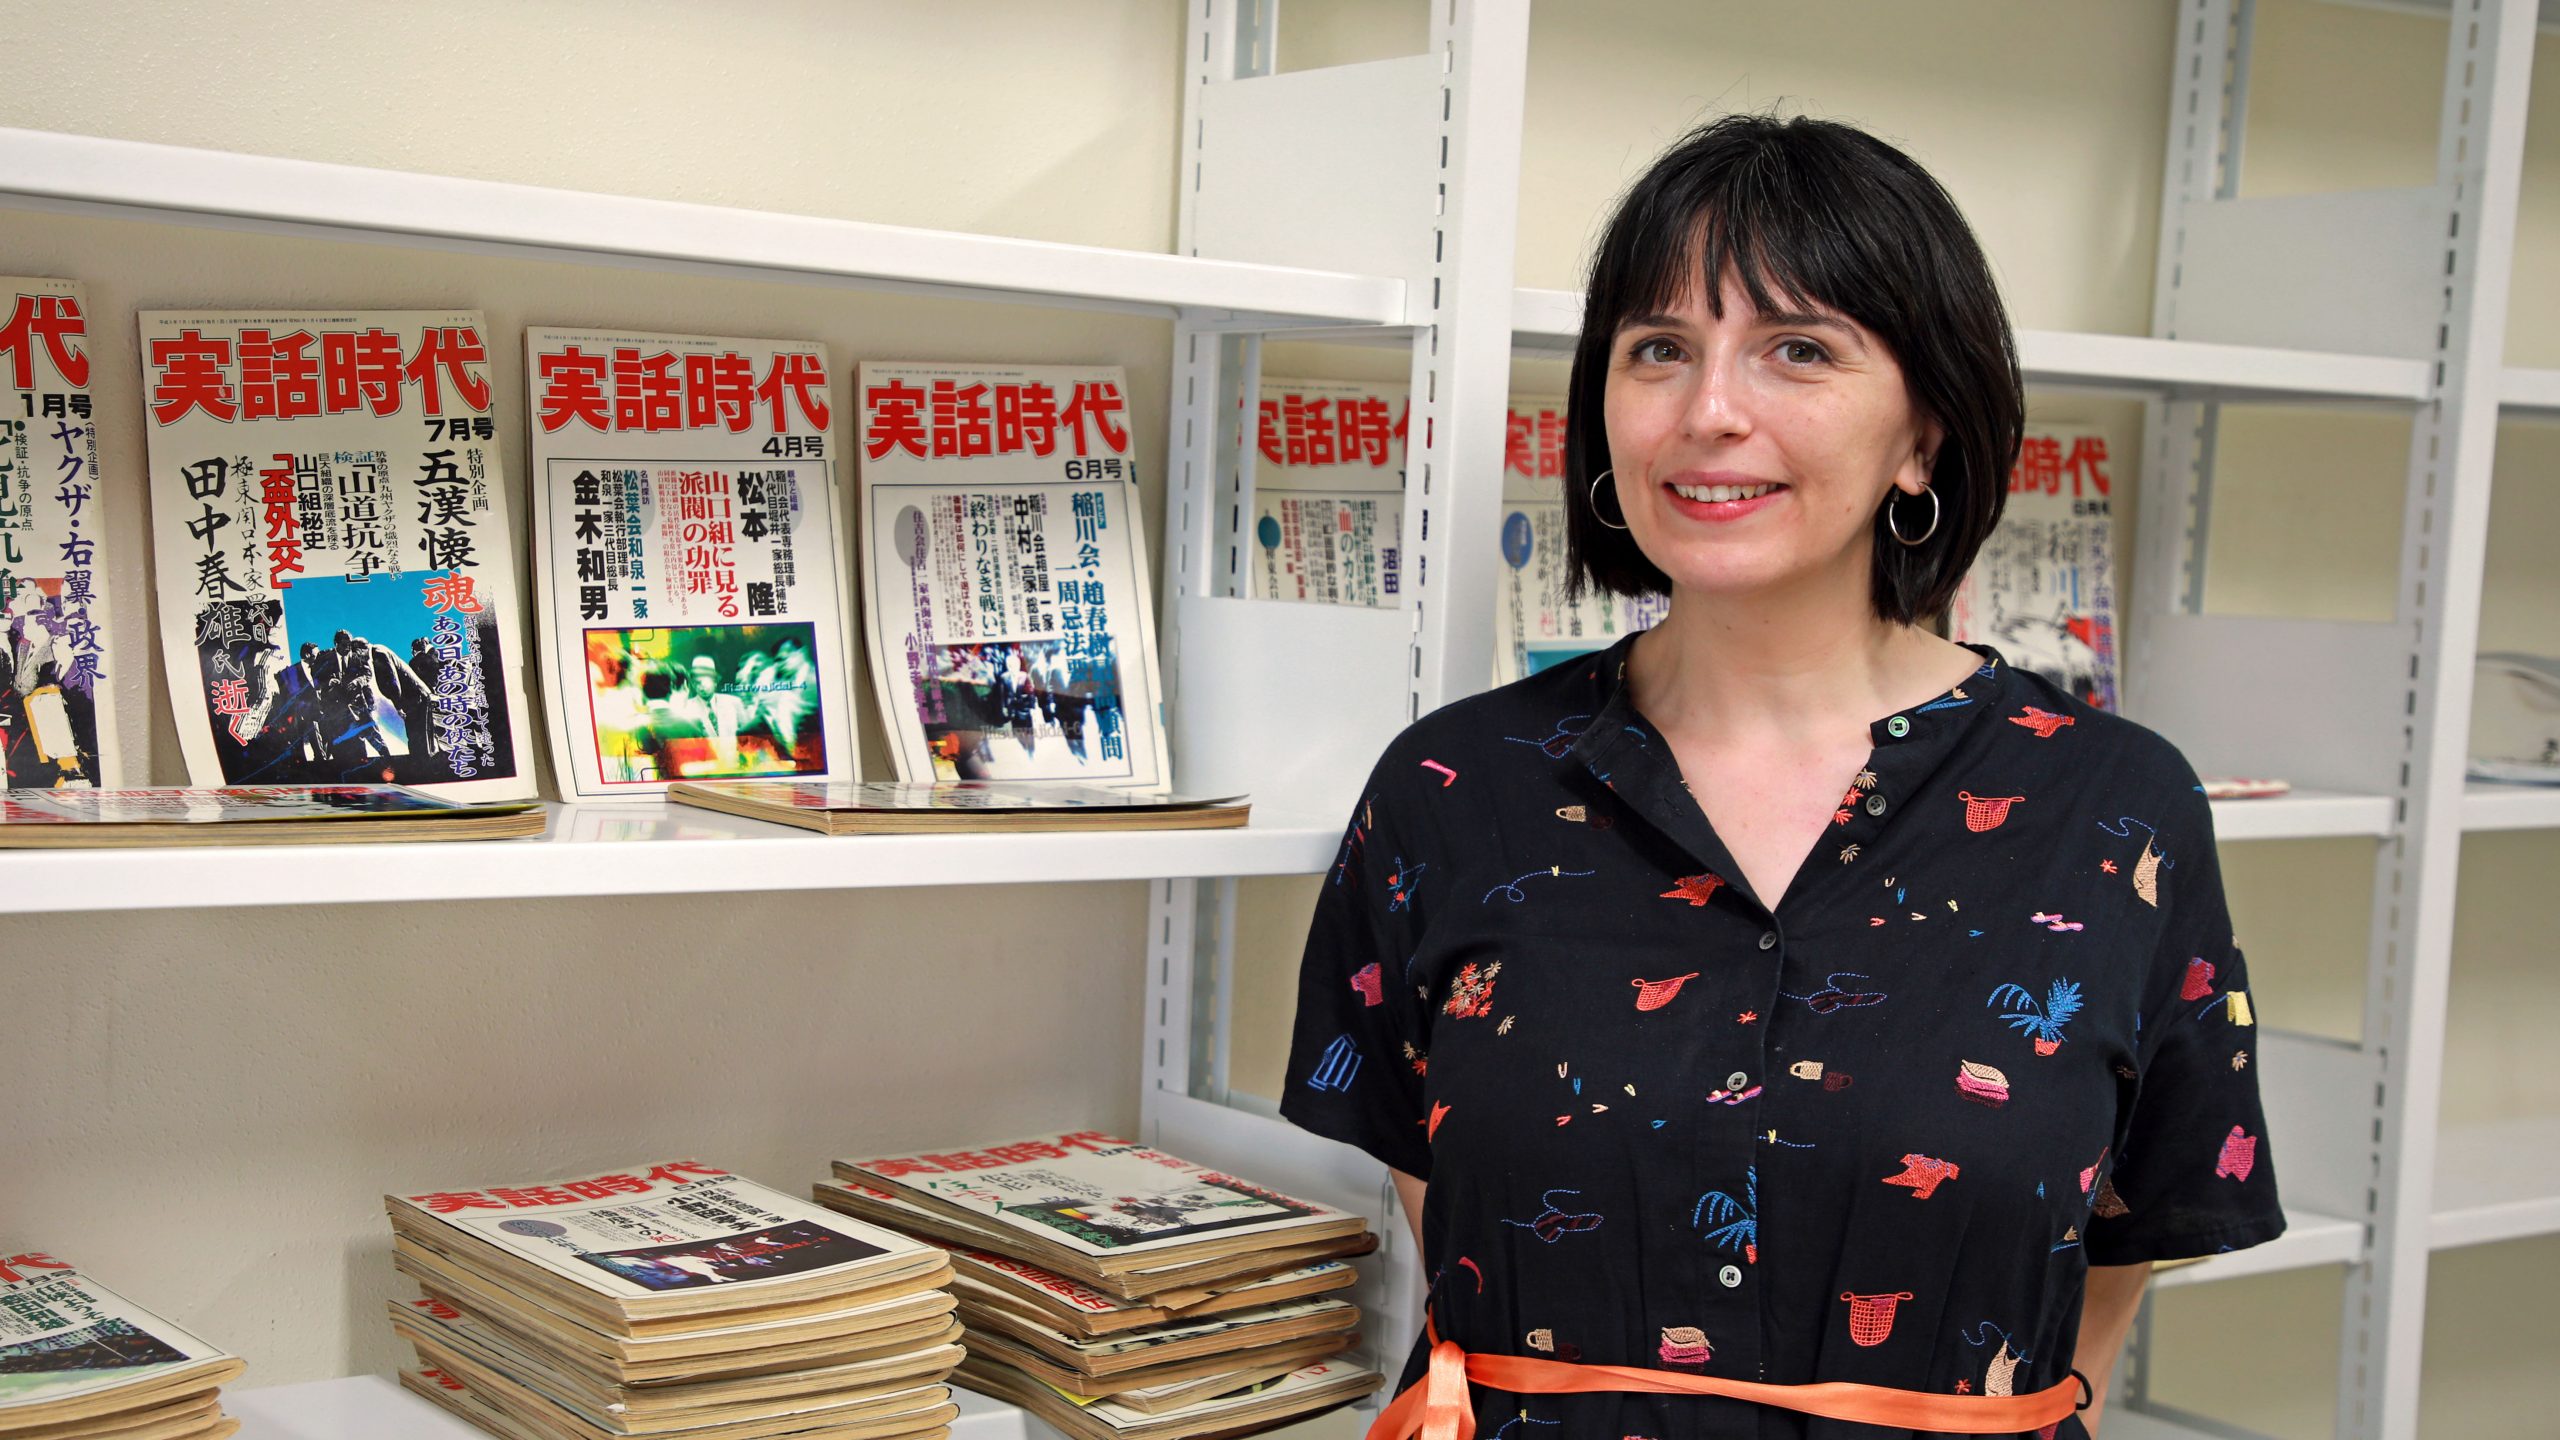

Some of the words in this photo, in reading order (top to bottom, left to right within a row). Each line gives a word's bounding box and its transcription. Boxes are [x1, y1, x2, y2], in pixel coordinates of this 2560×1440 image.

[20, 393, 93, 420] 1月号
[150, 327, 492, 427] 実話時代
[537, 345, 831, 434] 実話時代
[865, 378, 1129, 459] 実話時代
[334, 451, 376, 464] 検証
[424, 417, 494, 442] 7月号
[761, 436, 824, 457] 4月号
[1065, 459, 1122, 480] 6月号
[1258, 394, 1410, 467] 話時
[2006, 436, 2110, 497] 時代
[260, 453, 304, 589] 「盃外交」
[295, 454, 326, 551] 山口組秘史
[467, 448, 489, 512] 特別企画
[737, 471, 769, 543] 松本
[51, 421, 107, 688] ヤクザ・右翼・政界
[338, 463, 386, 583] 「山道抗争」
[573, 470, 608, 621] 金木和男
[601, 470, 618, 591] 和泉一家三代目総長
[612, 470, 629, 578] 松葉会執行部理事
[624, 470, 648, 619] 松葉会和泉一家
[678, 471, 713, 594] 派閥の功罪
[704, 471, 739, 618] 山口組に見る
[765, 470, 789, 615] 八代目堀井一家総長補佐
[1014, 494, 1031, 554] 中村
[746, 581, 777, 617] 隆
[970, 494, 998, 638] 「終わりなき戦い」
[410, 1161, 729, 1215] 実話時代
[856, 1131, 1135, 1177] 実話時代
